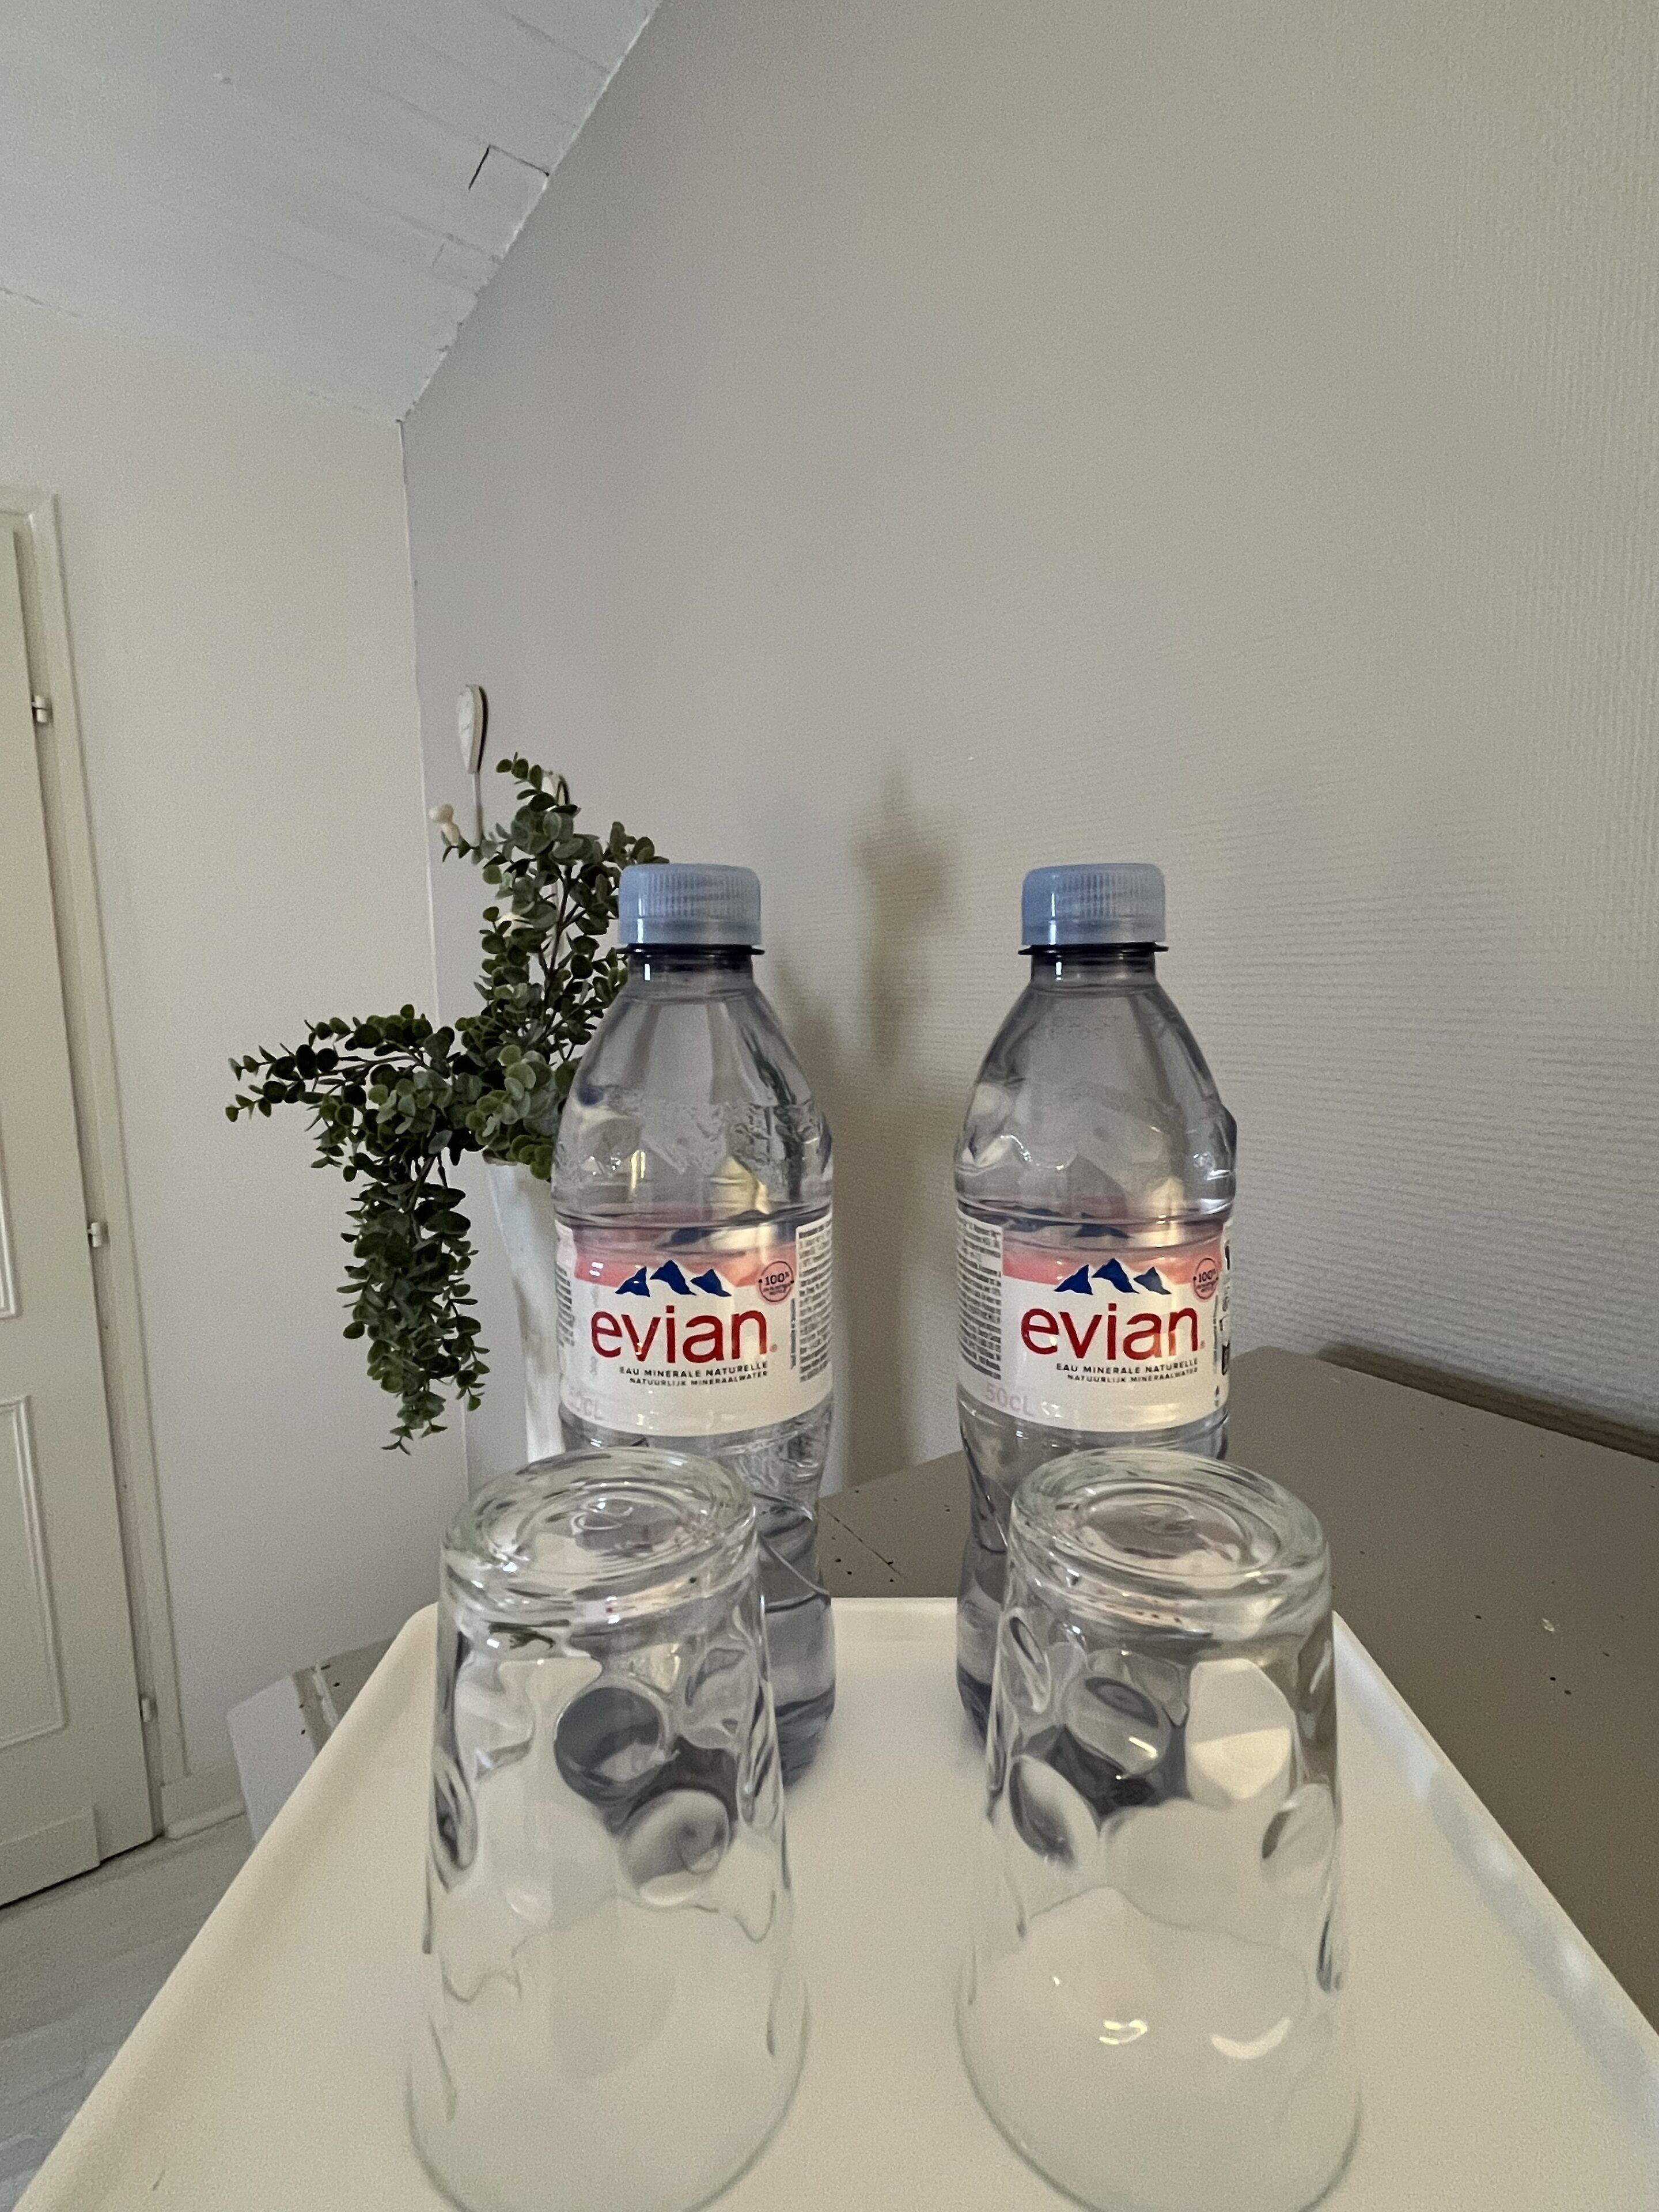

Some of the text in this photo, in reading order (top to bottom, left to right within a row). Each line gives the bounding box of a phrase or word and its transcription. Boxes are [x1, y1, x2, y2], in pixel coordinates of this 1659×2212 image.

[591, 1305, 768, 1363] evian
[1020, 1302, 1199, 1361] evian
[619, 1361, 768, 1378] EAU MINERALE NATURELLE
[1056, 1357, 1198, 1374] EAU MINERALE NATURELLE
[629, 1370, 768, 1387] NATUURLIJK MINERAALWATER
